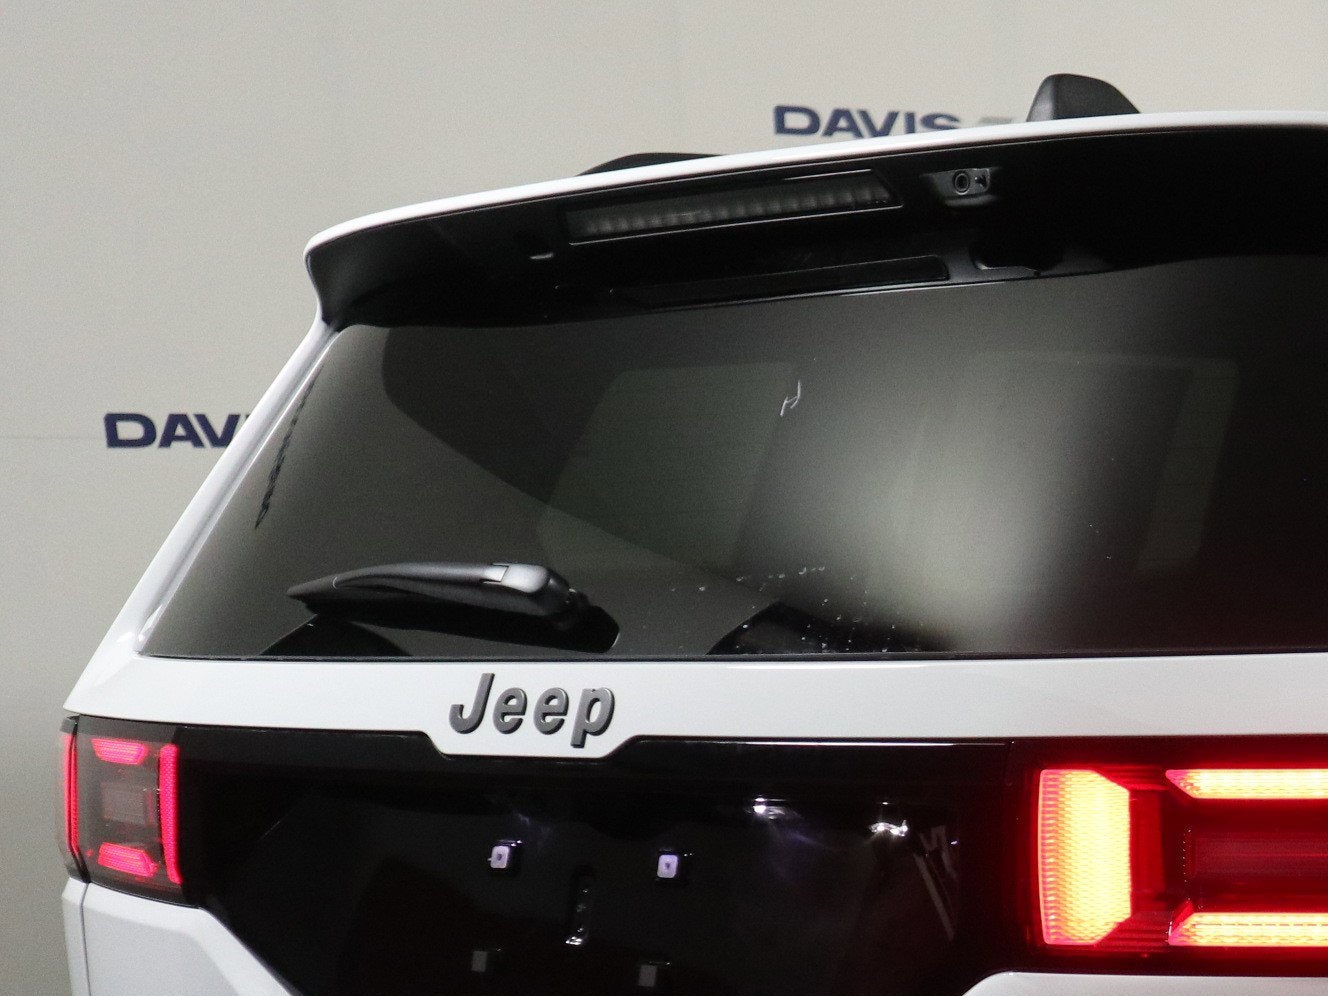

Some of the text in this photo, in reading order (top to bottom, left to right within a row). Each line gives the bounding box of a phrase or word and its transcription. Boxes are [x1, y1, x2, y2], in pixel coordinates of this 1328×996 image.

[774, 105, 960, 137] DAVIS
[104, 413, 251, 448] DAV
[449, 672, 615, 748] Jeep
